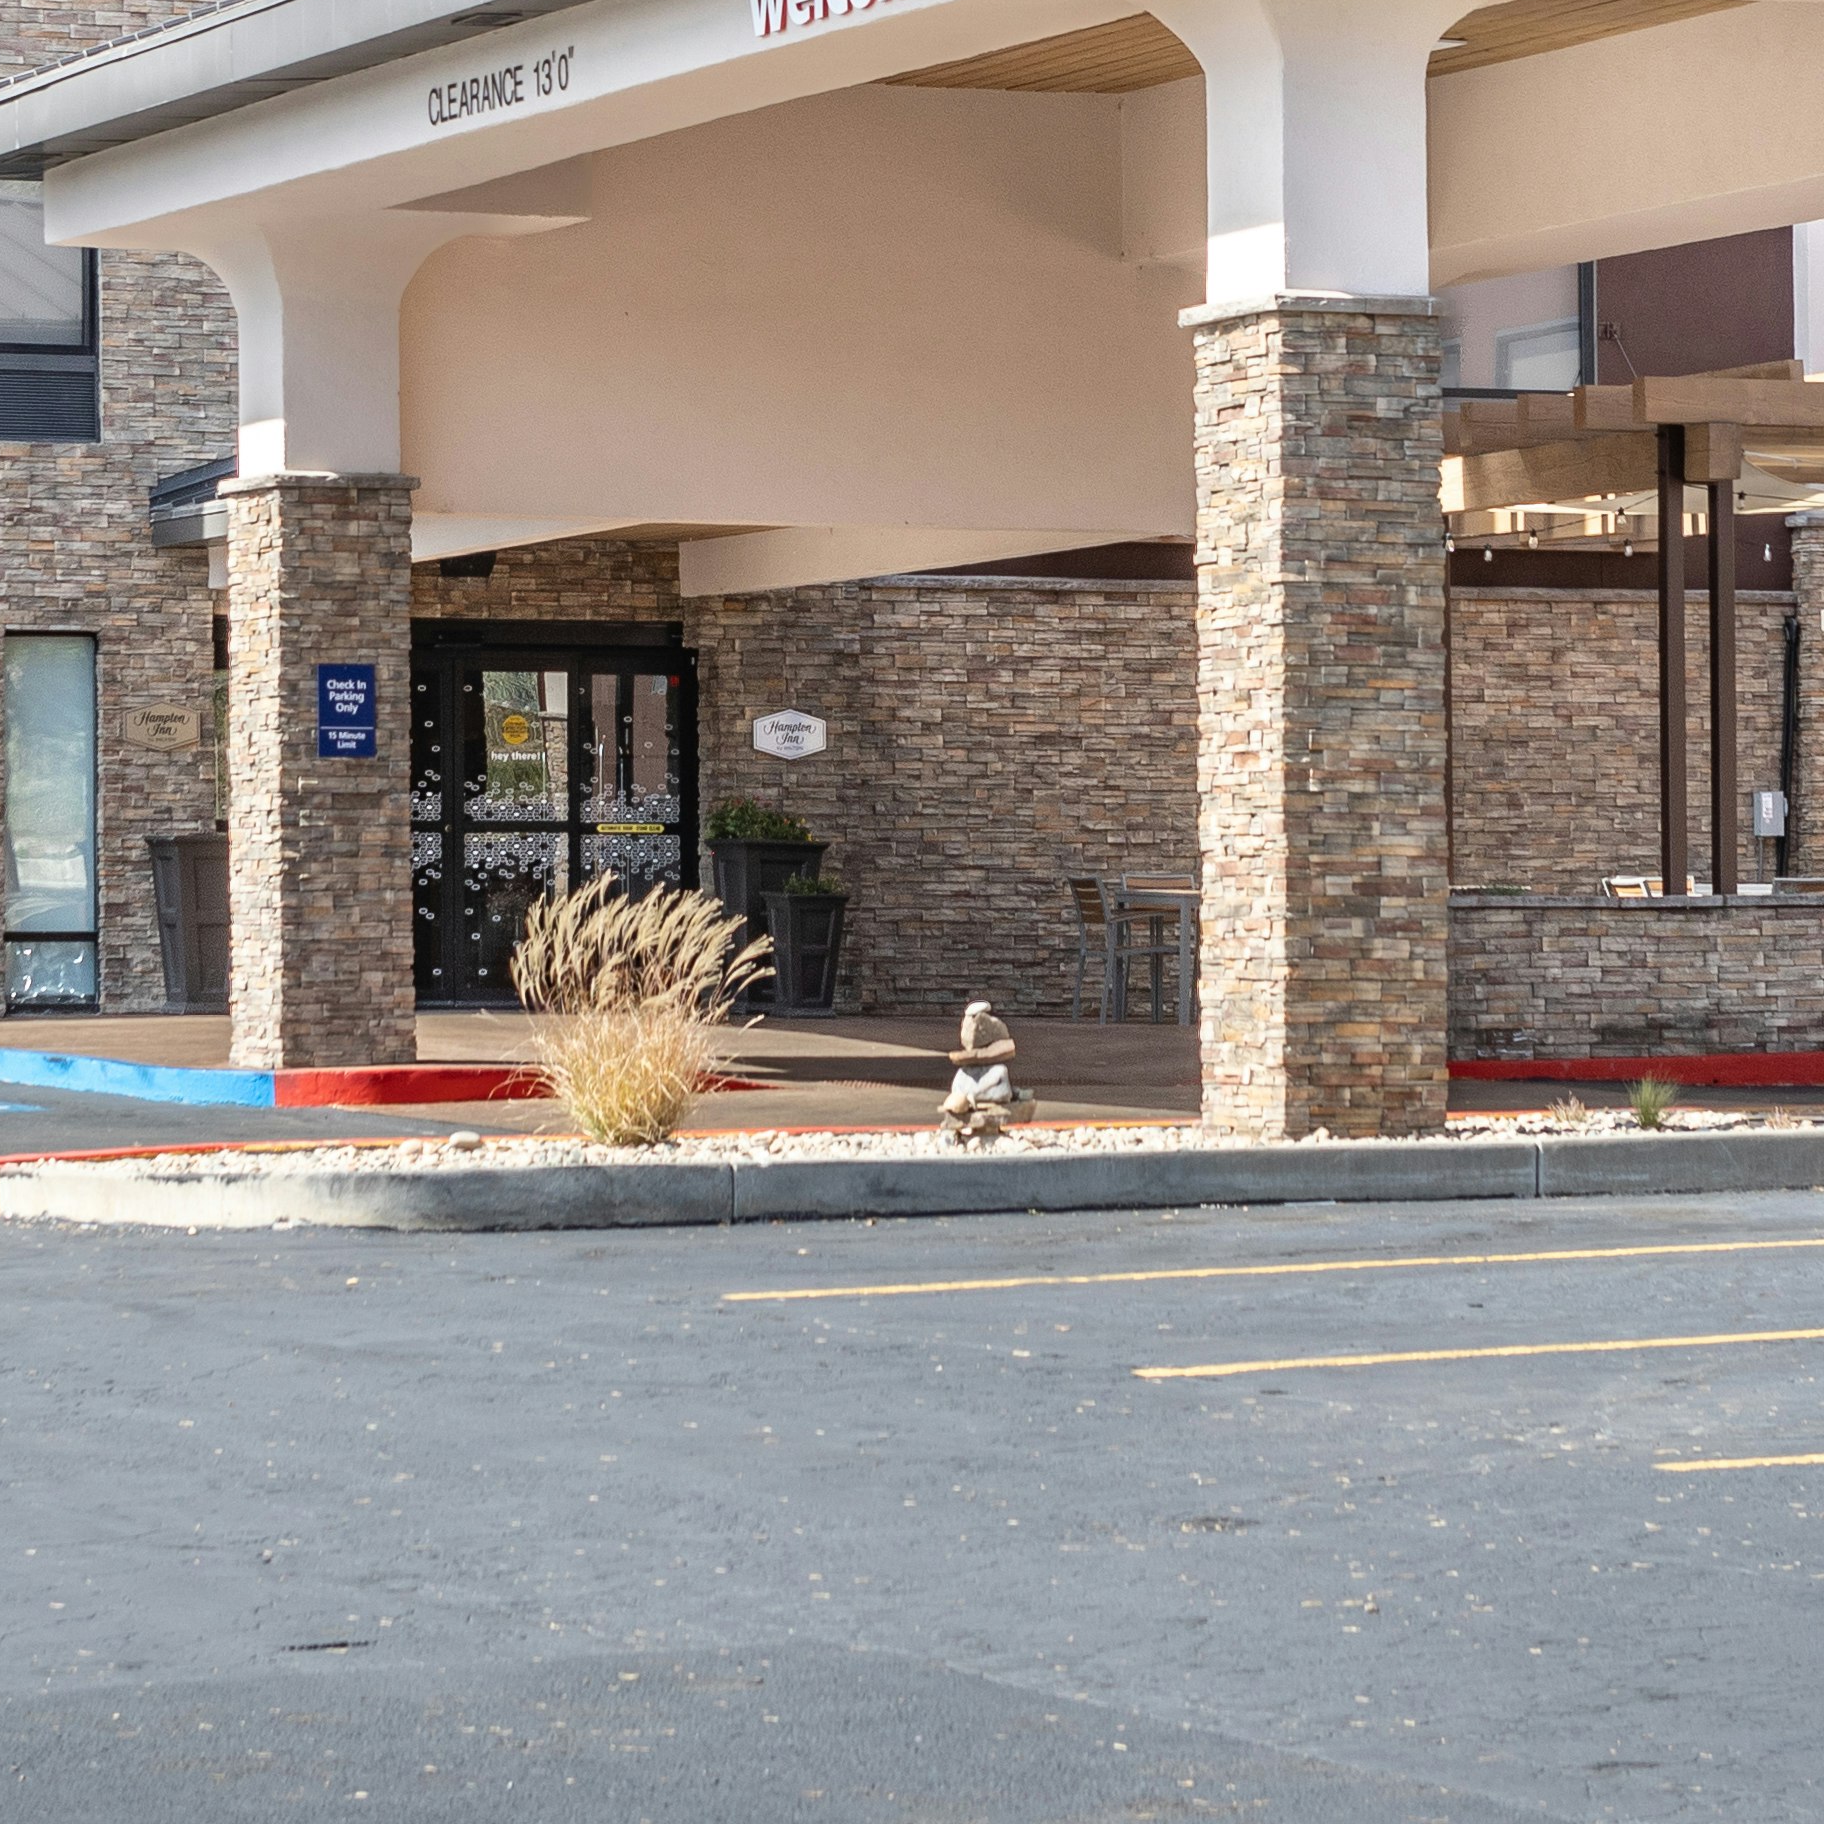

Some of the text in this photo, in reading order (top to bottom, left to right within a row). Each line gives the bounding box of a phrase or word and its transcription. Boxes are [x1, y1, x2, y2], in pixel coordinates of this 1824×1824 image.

[428, 45, 574, 126] CLEARANCE 13'0"
[326, 679, 367, 690] Check In
[329, 691, 365, 704] Parking
[335, 702, 359, 715] Only
[133, 711, 190, 727] Hampton
[147, 723, 177, 736] Inn
[764, 720, 816, 735] Hampton
[328, 731, 366, 740] 15 Minute
[776, 734, 804, 745] Inn
[337, 740, 357, 749] Limit
[491, 751, 541, 763] hey there!
